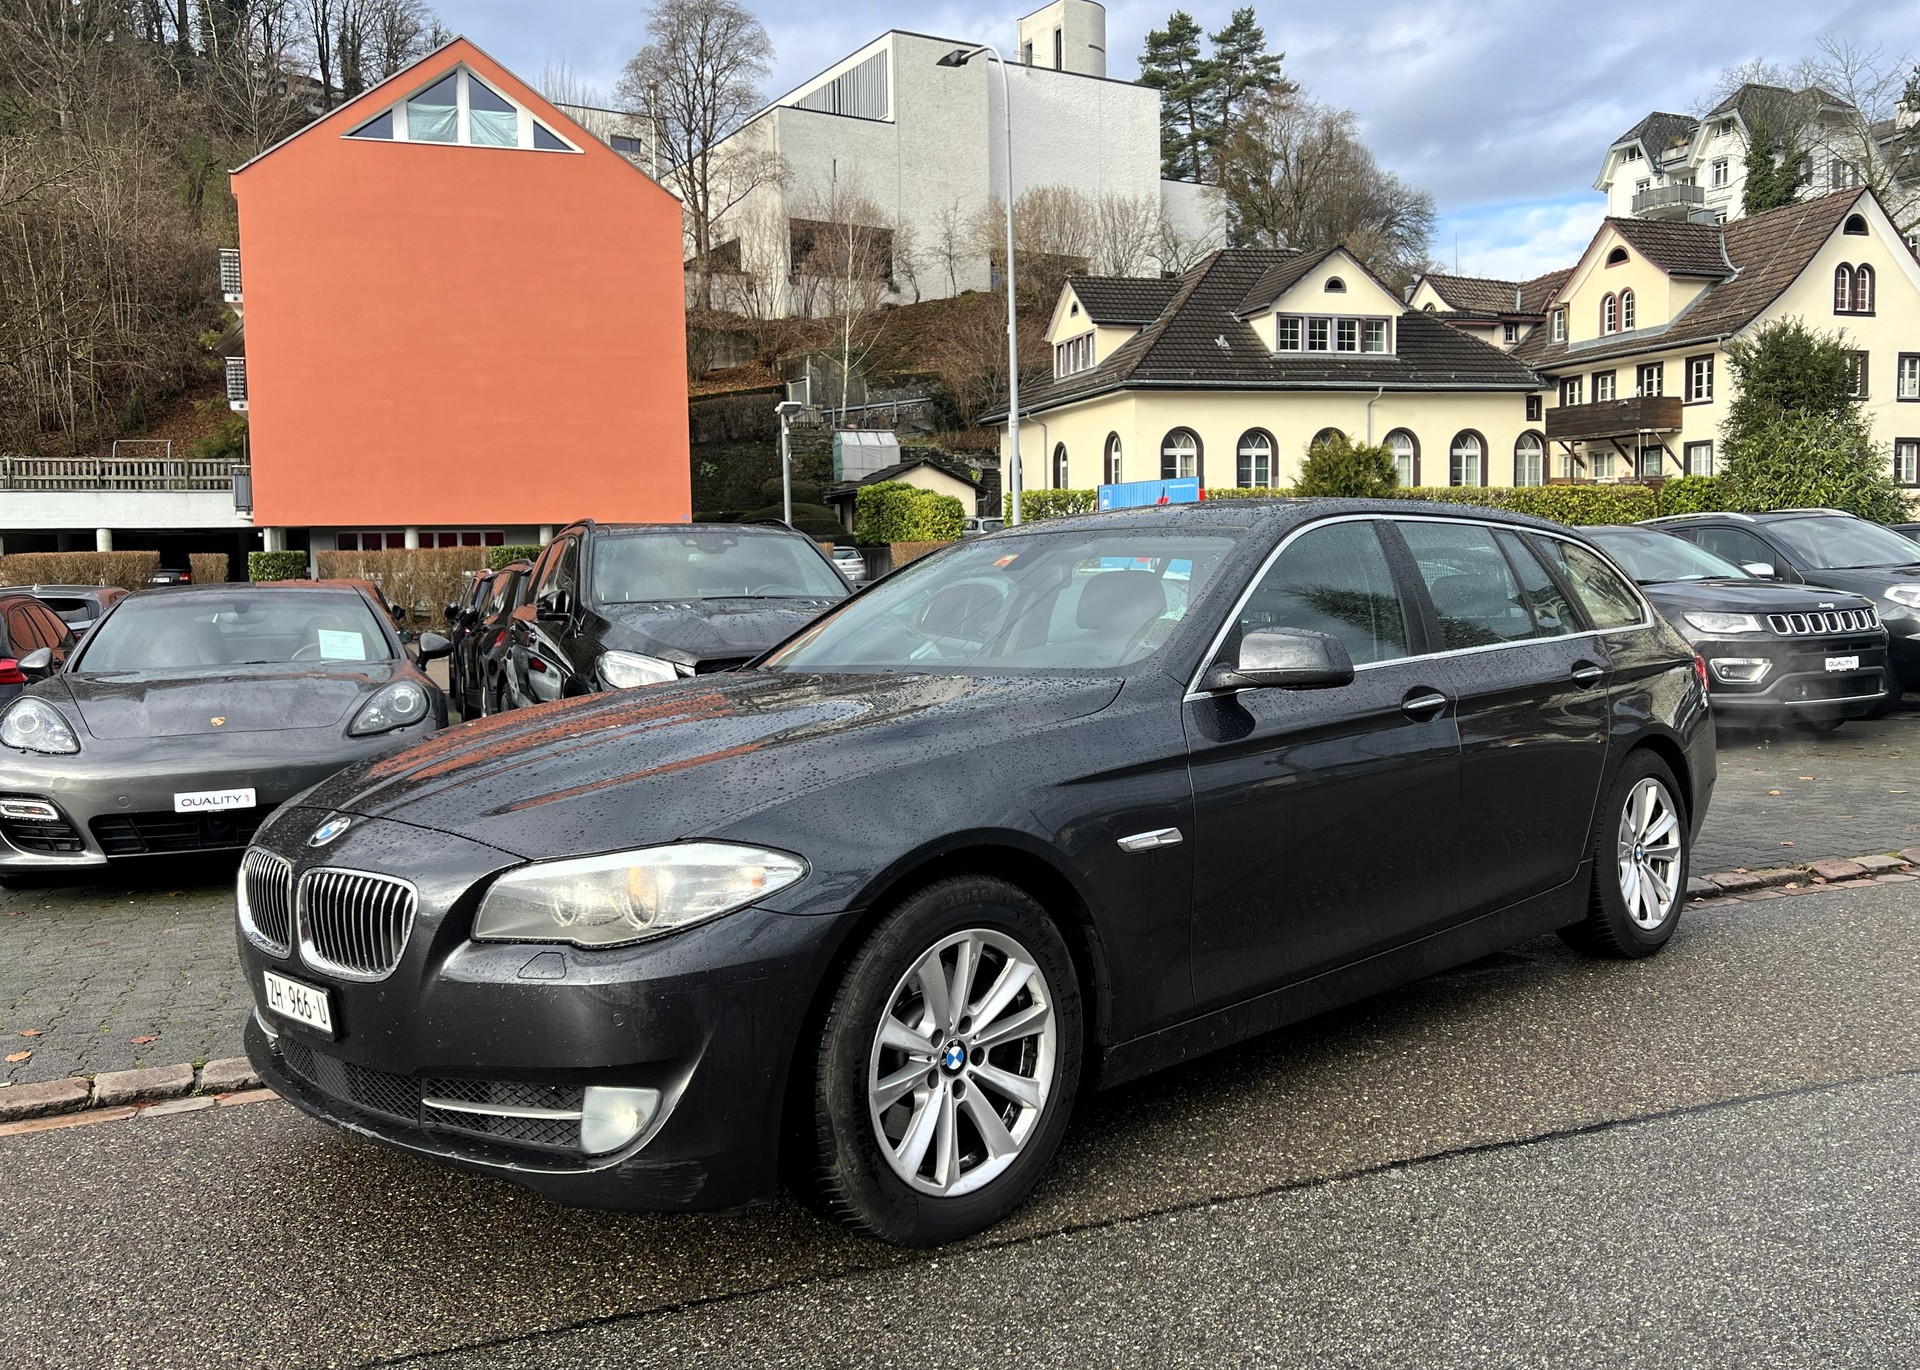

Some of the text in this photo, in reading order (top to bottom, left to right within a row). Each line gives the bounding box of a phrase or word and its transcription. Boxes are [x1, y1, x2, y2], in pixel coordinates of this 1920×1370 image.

[1828, 659, 1853, 667] QUALITY
[181, 794, 250, 807] QUALITY 1
